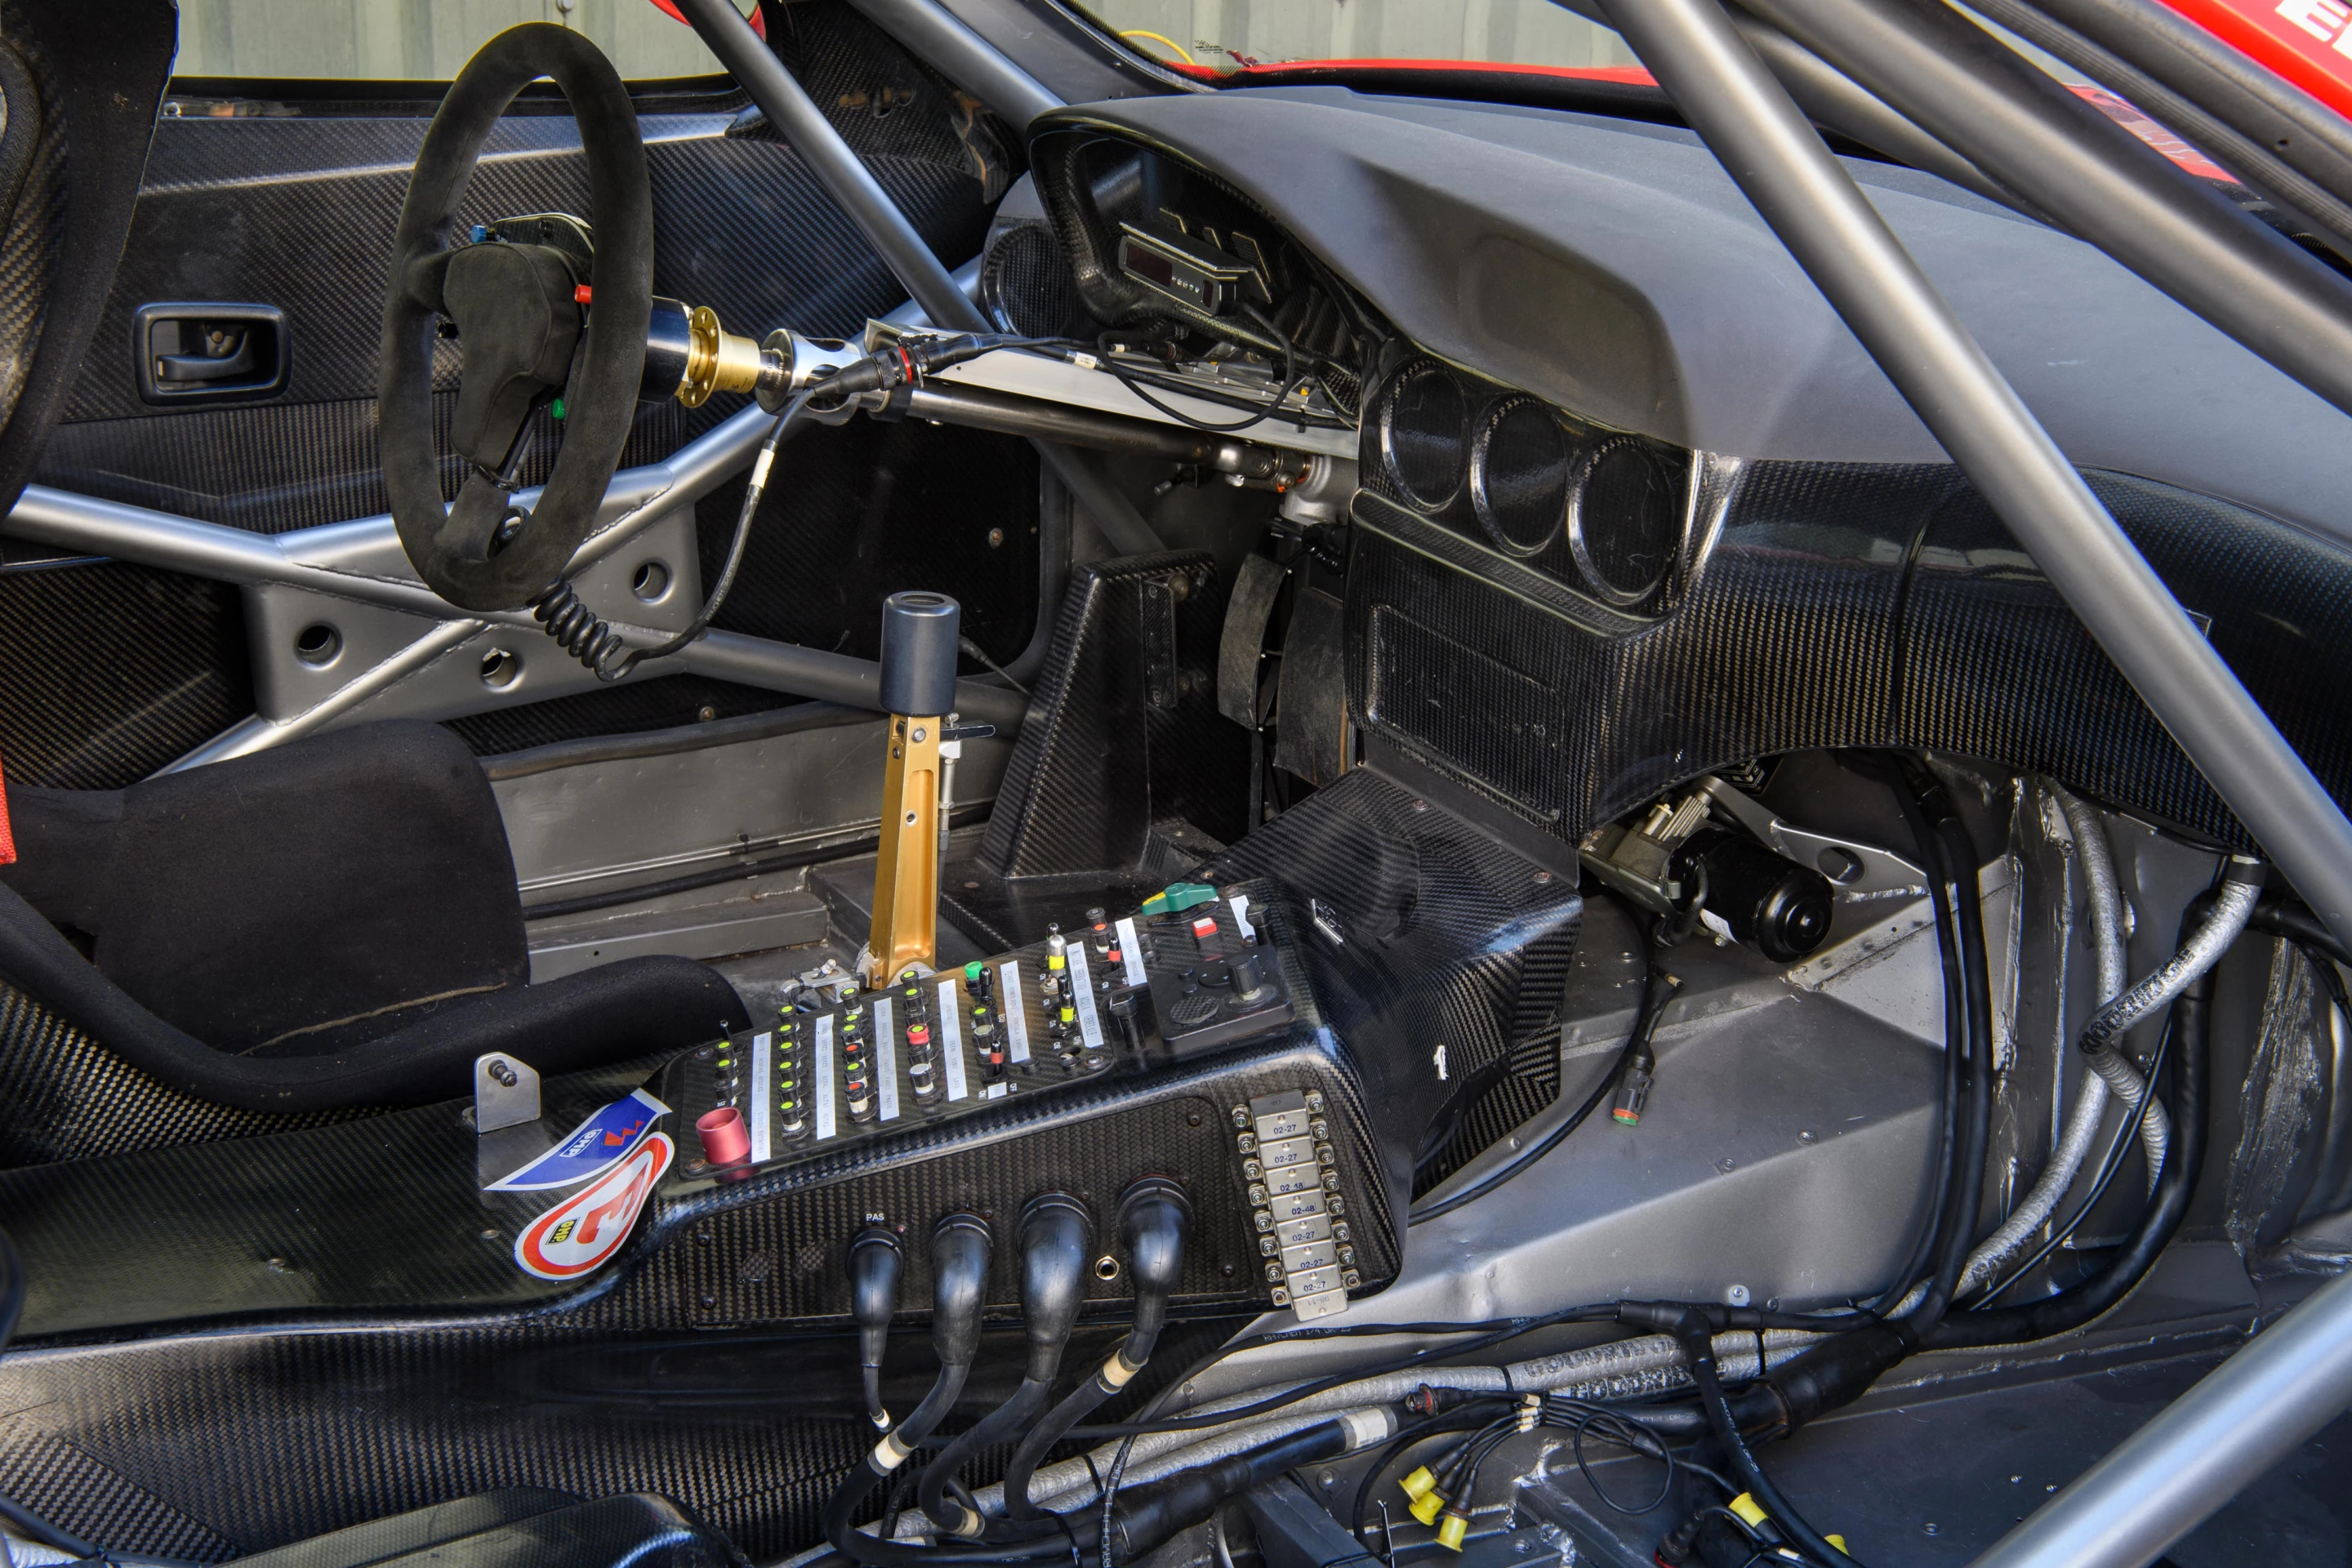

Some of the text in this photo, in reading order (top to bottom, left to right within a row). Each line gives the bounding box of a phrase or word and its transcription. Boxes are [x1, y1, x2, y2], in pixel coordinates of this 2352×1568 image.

[705, 590, 725, 621] RAYCHEM
[1273, 1125, 1297, 1134] 02-27
[567, 1130, 597, 1156] OMP
[1274, 1153, 1298, 1164] 02-27
[866, 1213, 884, 1222] PAS
[1292, 1231, 1316, 1241] 02-27
[1300, 1258, 1323, 1269] 02-27
[1303, 1281, 1326, 1292] 02-27
[1743, 1449, 1760, 1472] DR-25
[1102, 1441, 1132, 1568] RAYCHEM 1/4 DR-25
